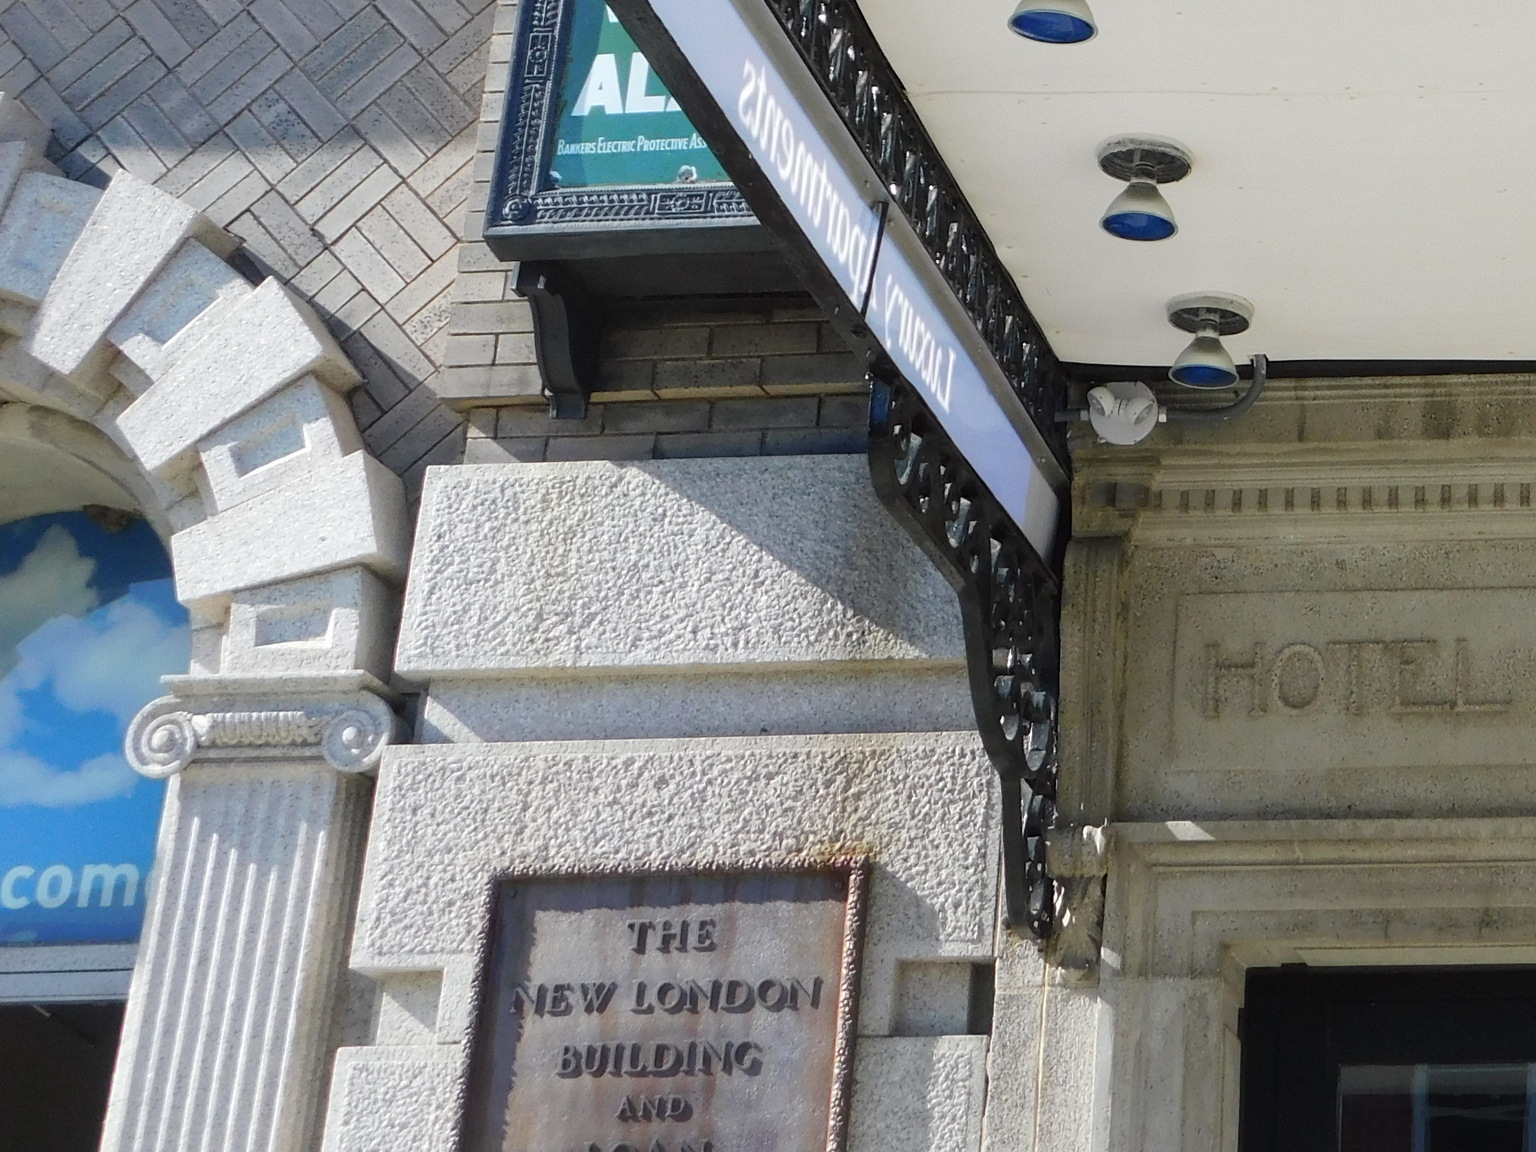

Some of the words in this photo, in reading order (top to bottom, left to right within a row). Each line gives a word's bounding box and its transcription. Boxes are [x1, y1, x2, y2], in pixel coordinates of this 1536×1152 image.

[571, 51, 683, 117] AL
[597, 136, 636, 154] ELECTRIC
[637, 135, 689, 152] PROTECTIVE
[1203, 637, 1513, 720] HOTEL
[625, 918, 717, 955] THE
[510, 981, 618, 1018] NEW
[630, 975, 824, 1015] LONDON
[556, 1039, 763, 1079] BUILDING
[615, 1094, 694, 1123] AND
